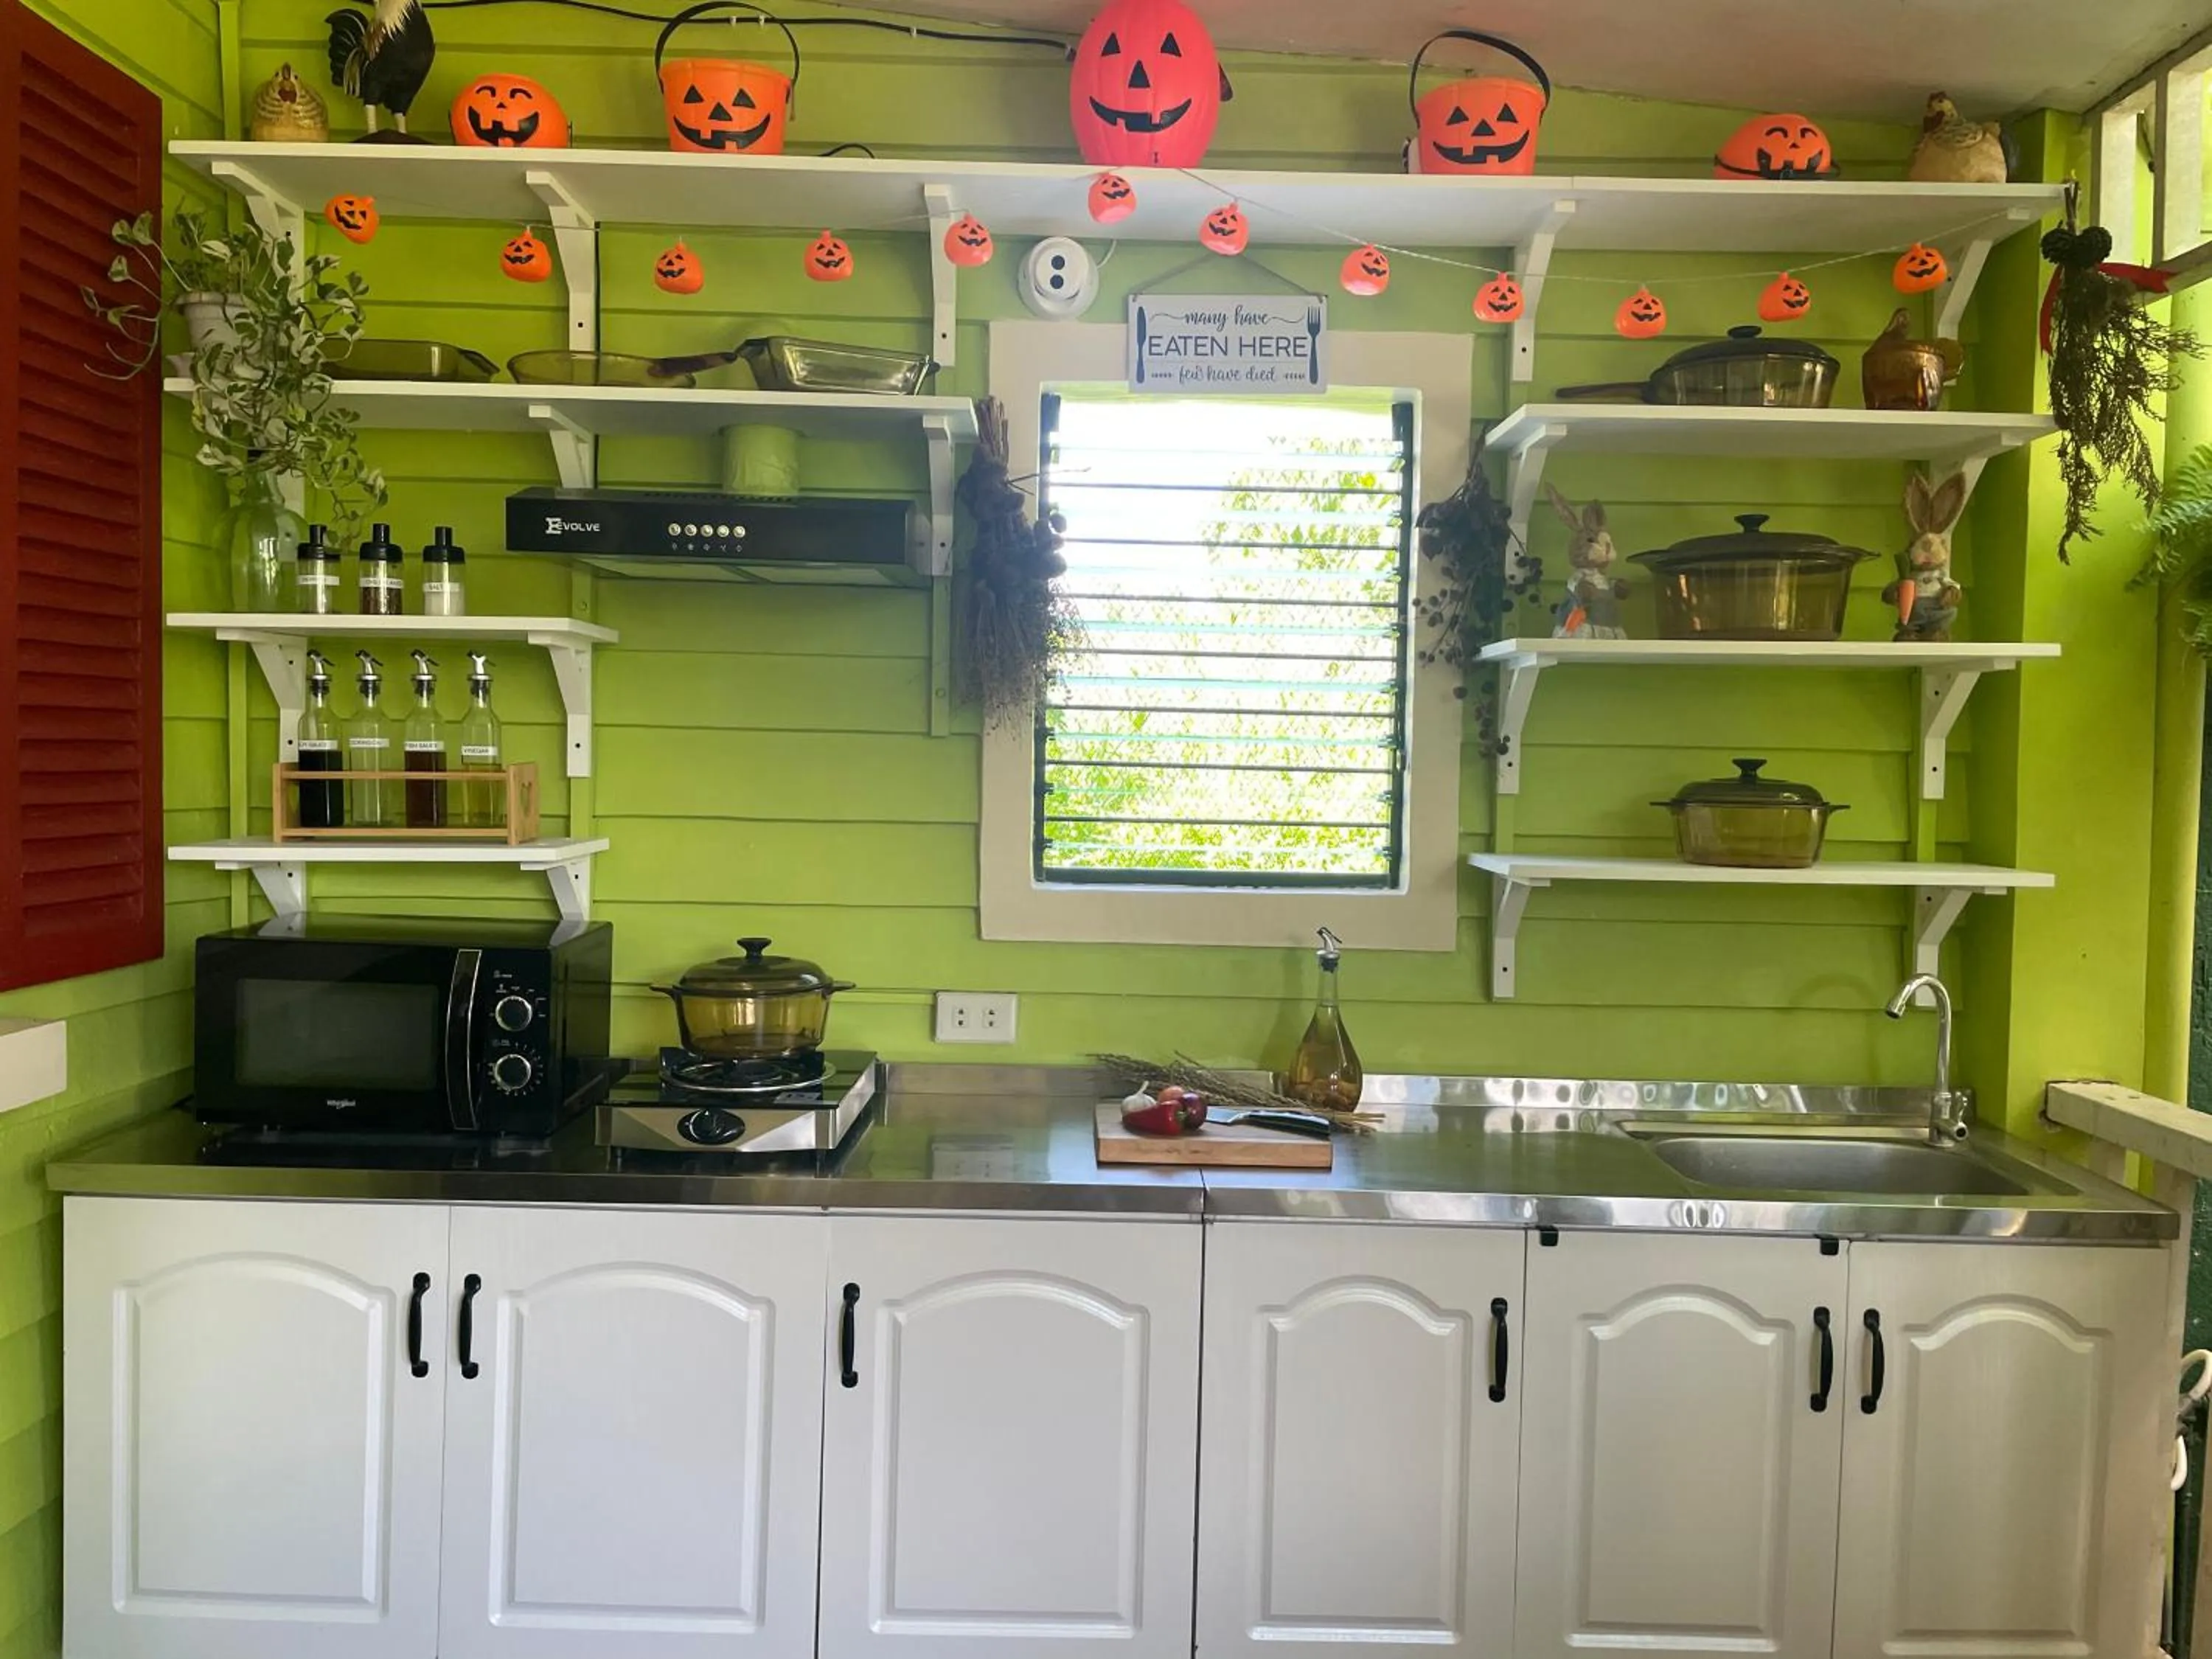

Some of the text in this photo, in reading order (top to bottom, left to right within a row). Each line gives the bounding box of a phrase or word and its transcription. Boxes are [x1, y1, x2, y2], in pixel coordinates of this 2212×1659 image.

[1184, 305, 1268, 332] many have
[1148, 335, 1308, 357] EATEN HERE
[1207, 365, 1241, 381] have
[1245, 366, 1276, 381] died
